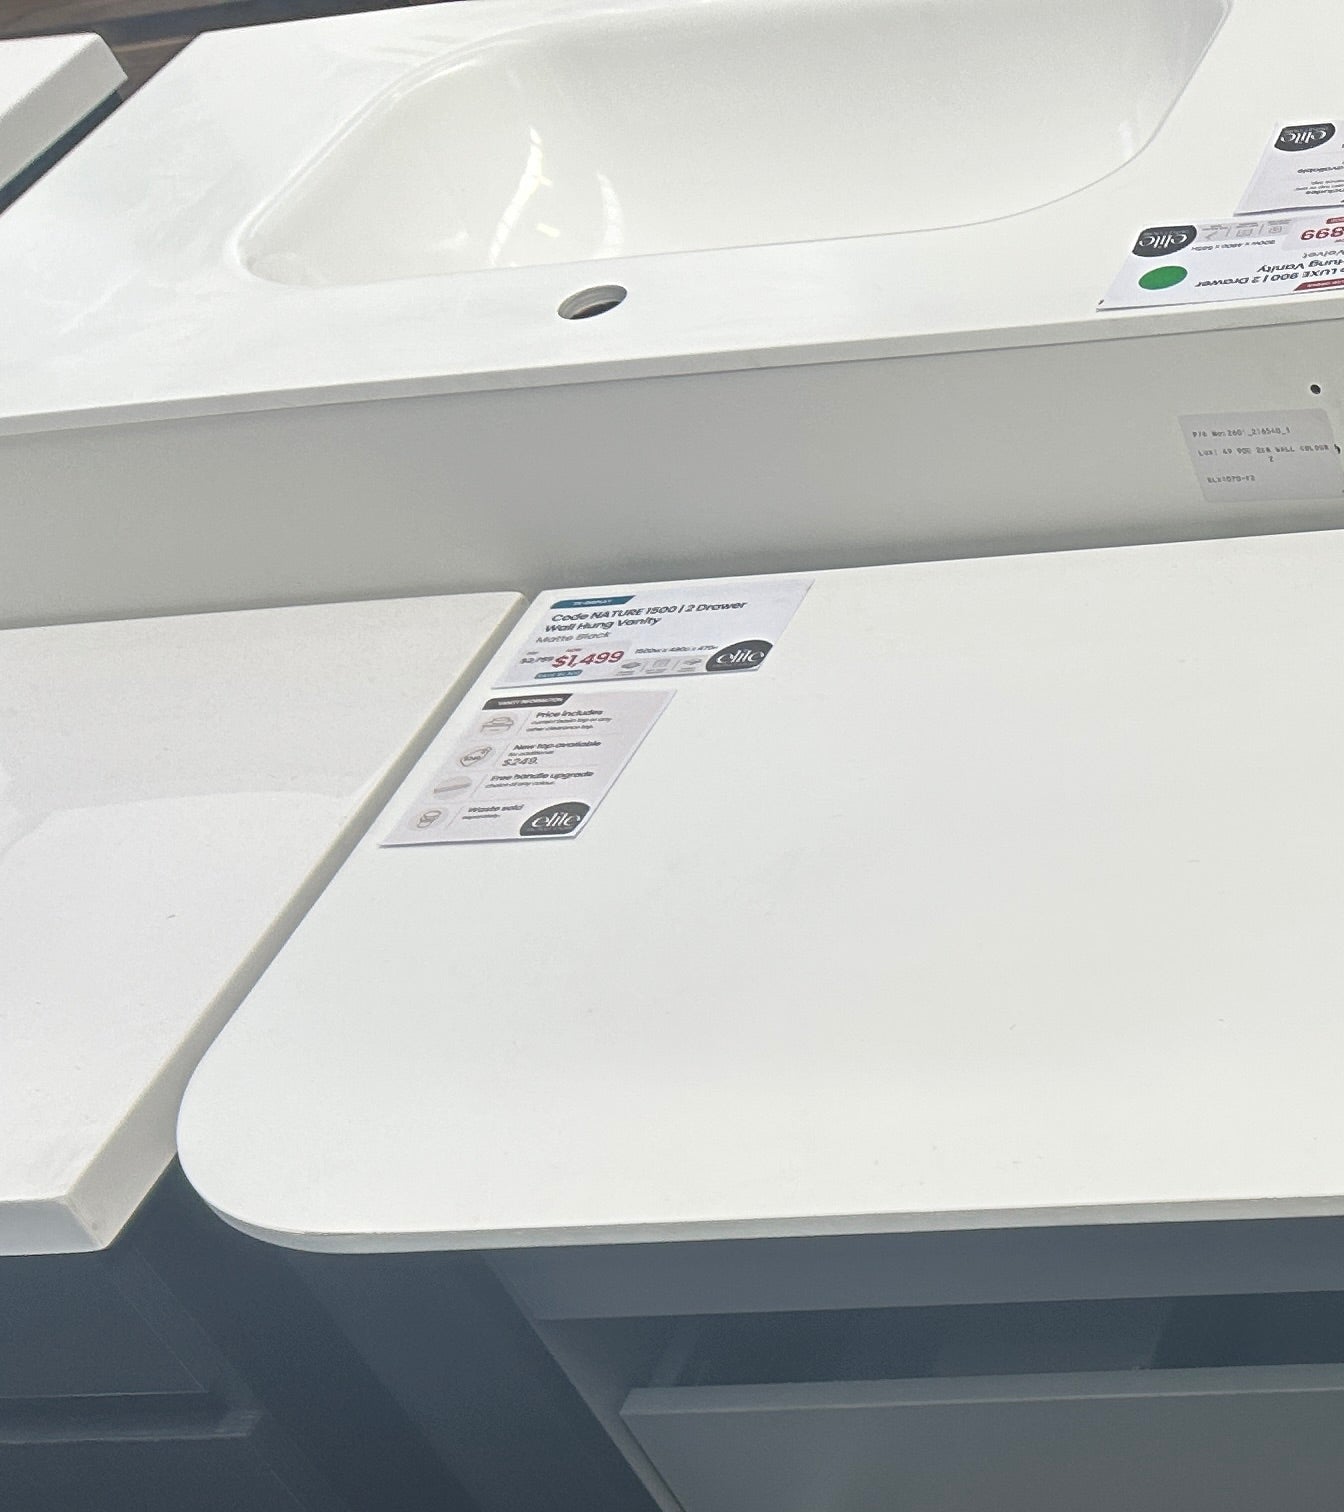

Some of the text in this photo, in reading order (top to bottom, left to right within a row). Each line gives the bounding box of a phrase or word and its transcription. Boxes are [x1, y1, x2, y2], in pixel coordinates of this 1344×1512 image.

[1280, 131, 1328, 145] elite
[1138, 230, 1188, 249] elite
[1302, 248, 1344, 259] Velvet
[1257, 262, 1305, 274] Vanity
[1302, 268, 1336, 279] LUXE
[1195, 276, 1248, 288] Drawer
[551, 610, 589, 622] Code
[589, 608, 645, 620] NATURE
[645, 605, 676, 616] 1500
[695, 602, 748, 612] Drawer
[545, 616, 662, 633] Wall Hung Vanity
[535, 631, 612, 644] Matte Black
[552, 650, 625, 669] $1,499
[717, 649, 765, 665] elite
[513, 743, 534, 751] New
[490, 771, 595, 782] Free handle upgrade
[531, 811, 581, 827] elite
